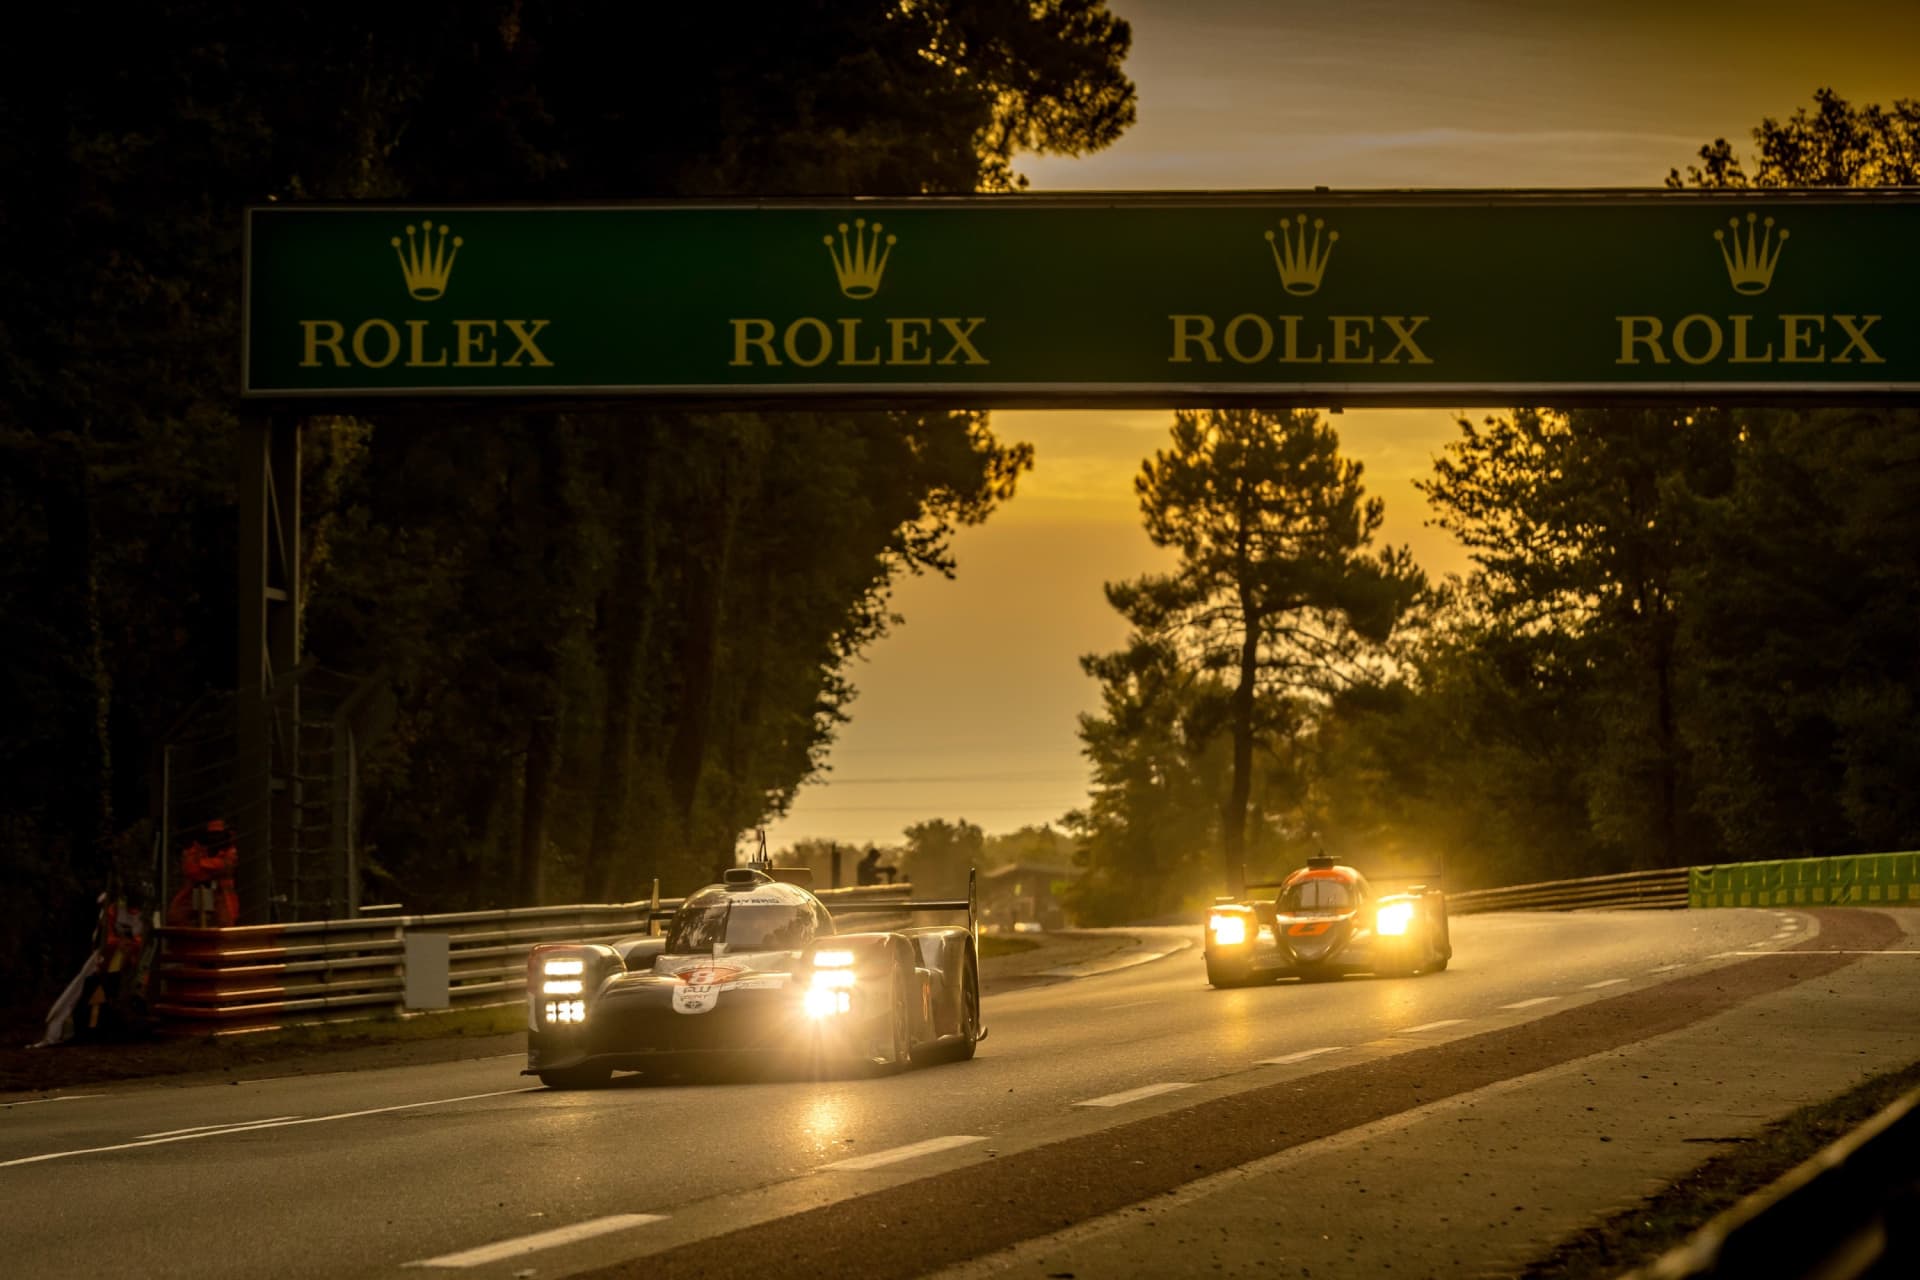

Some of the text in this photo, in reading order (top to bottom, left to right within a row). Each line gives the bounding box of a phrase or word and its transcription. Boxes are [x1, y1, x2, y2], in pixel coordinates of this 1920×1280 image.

[299, 318, 555, 368] ROLEX
[728, 316, 991, 367] ROLEX
[1166, 313, 1435, 365] ROLEX
[1614, 313, 1887, 366] ROLEX
